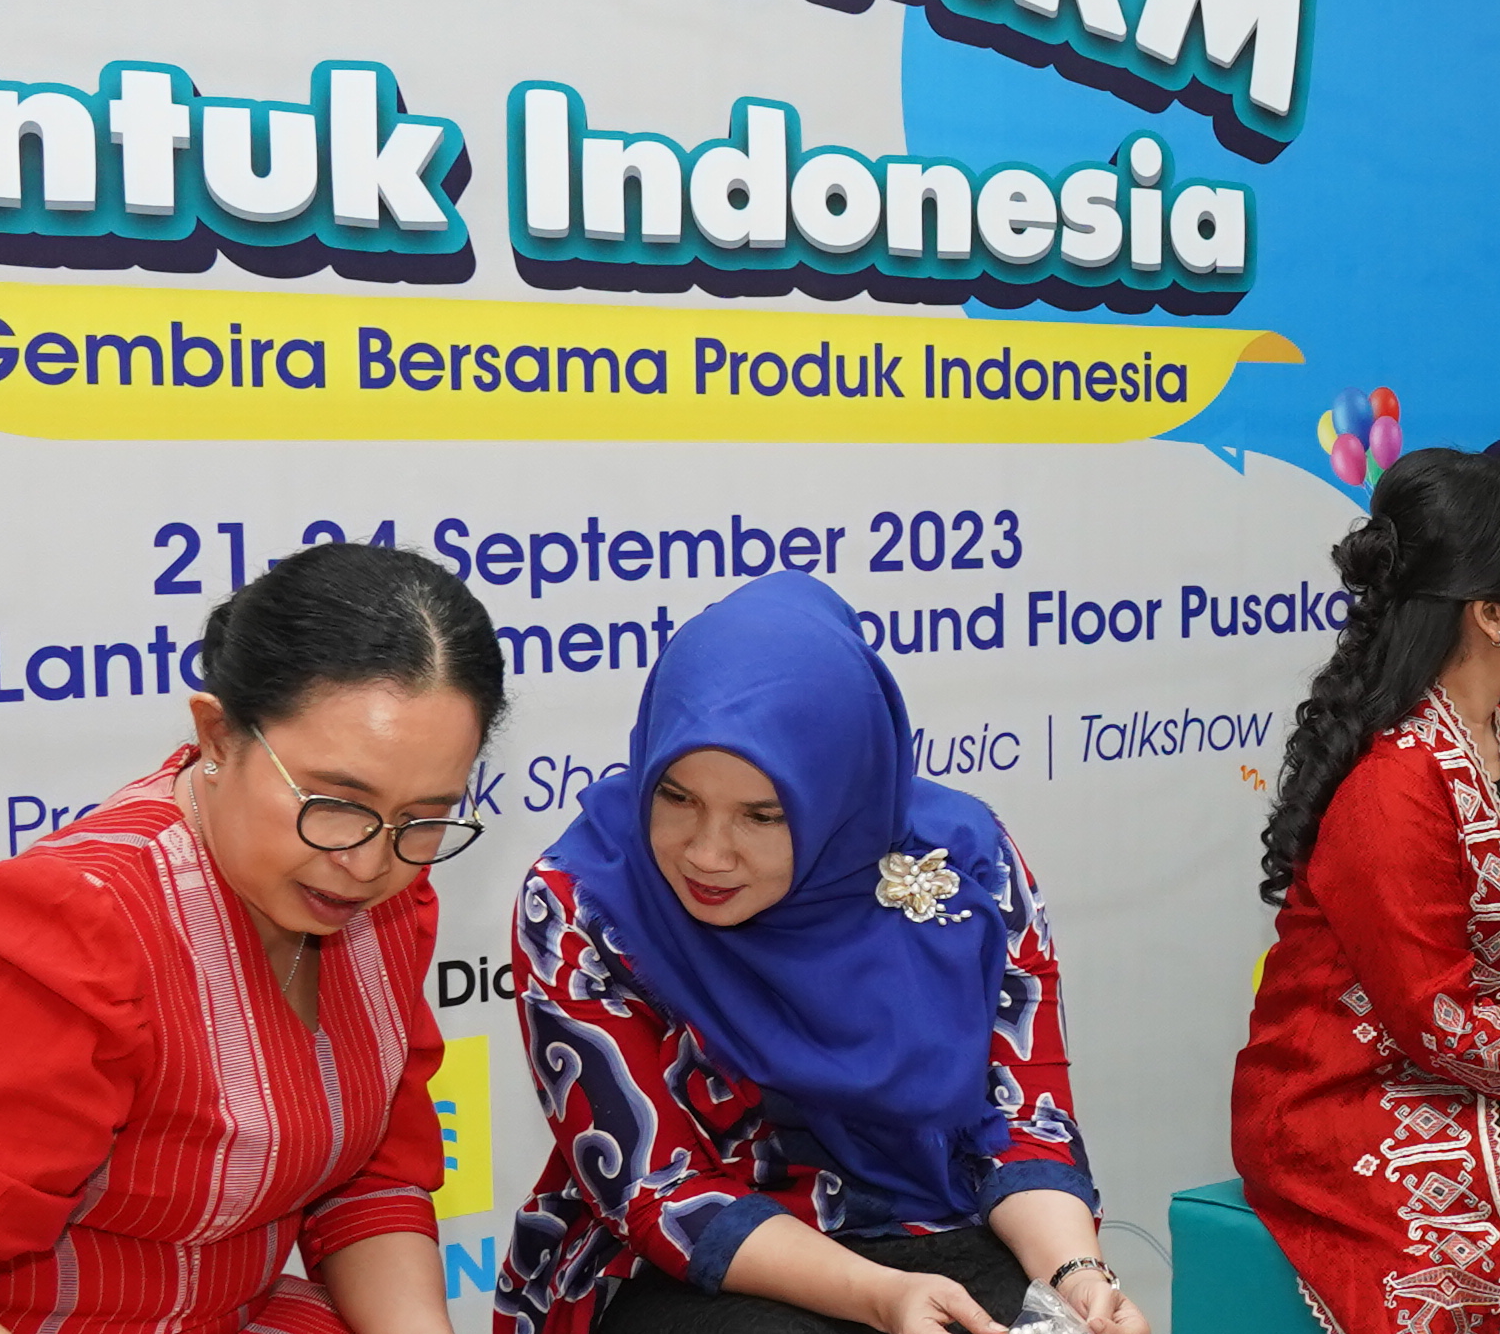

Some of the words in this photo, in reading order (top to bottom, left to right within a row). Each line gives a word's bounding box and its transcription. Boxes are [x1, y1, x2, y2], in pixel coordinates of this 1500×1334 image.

[524, 87, 1248, 273] Indonesia
[358, 326, 668, 395] Bersama
[694, 336, 903, 399] Produk
[924, 347, 1189, 404] Indonesia
[433, 513, 846, 598] September
[868, 509, 1024, 575] 2023
[1028, 590, 1163, 646] Floor
[1181, 580, 1356, 639] Pusaka
[1077, 707, 1273, 765] Talkshow
